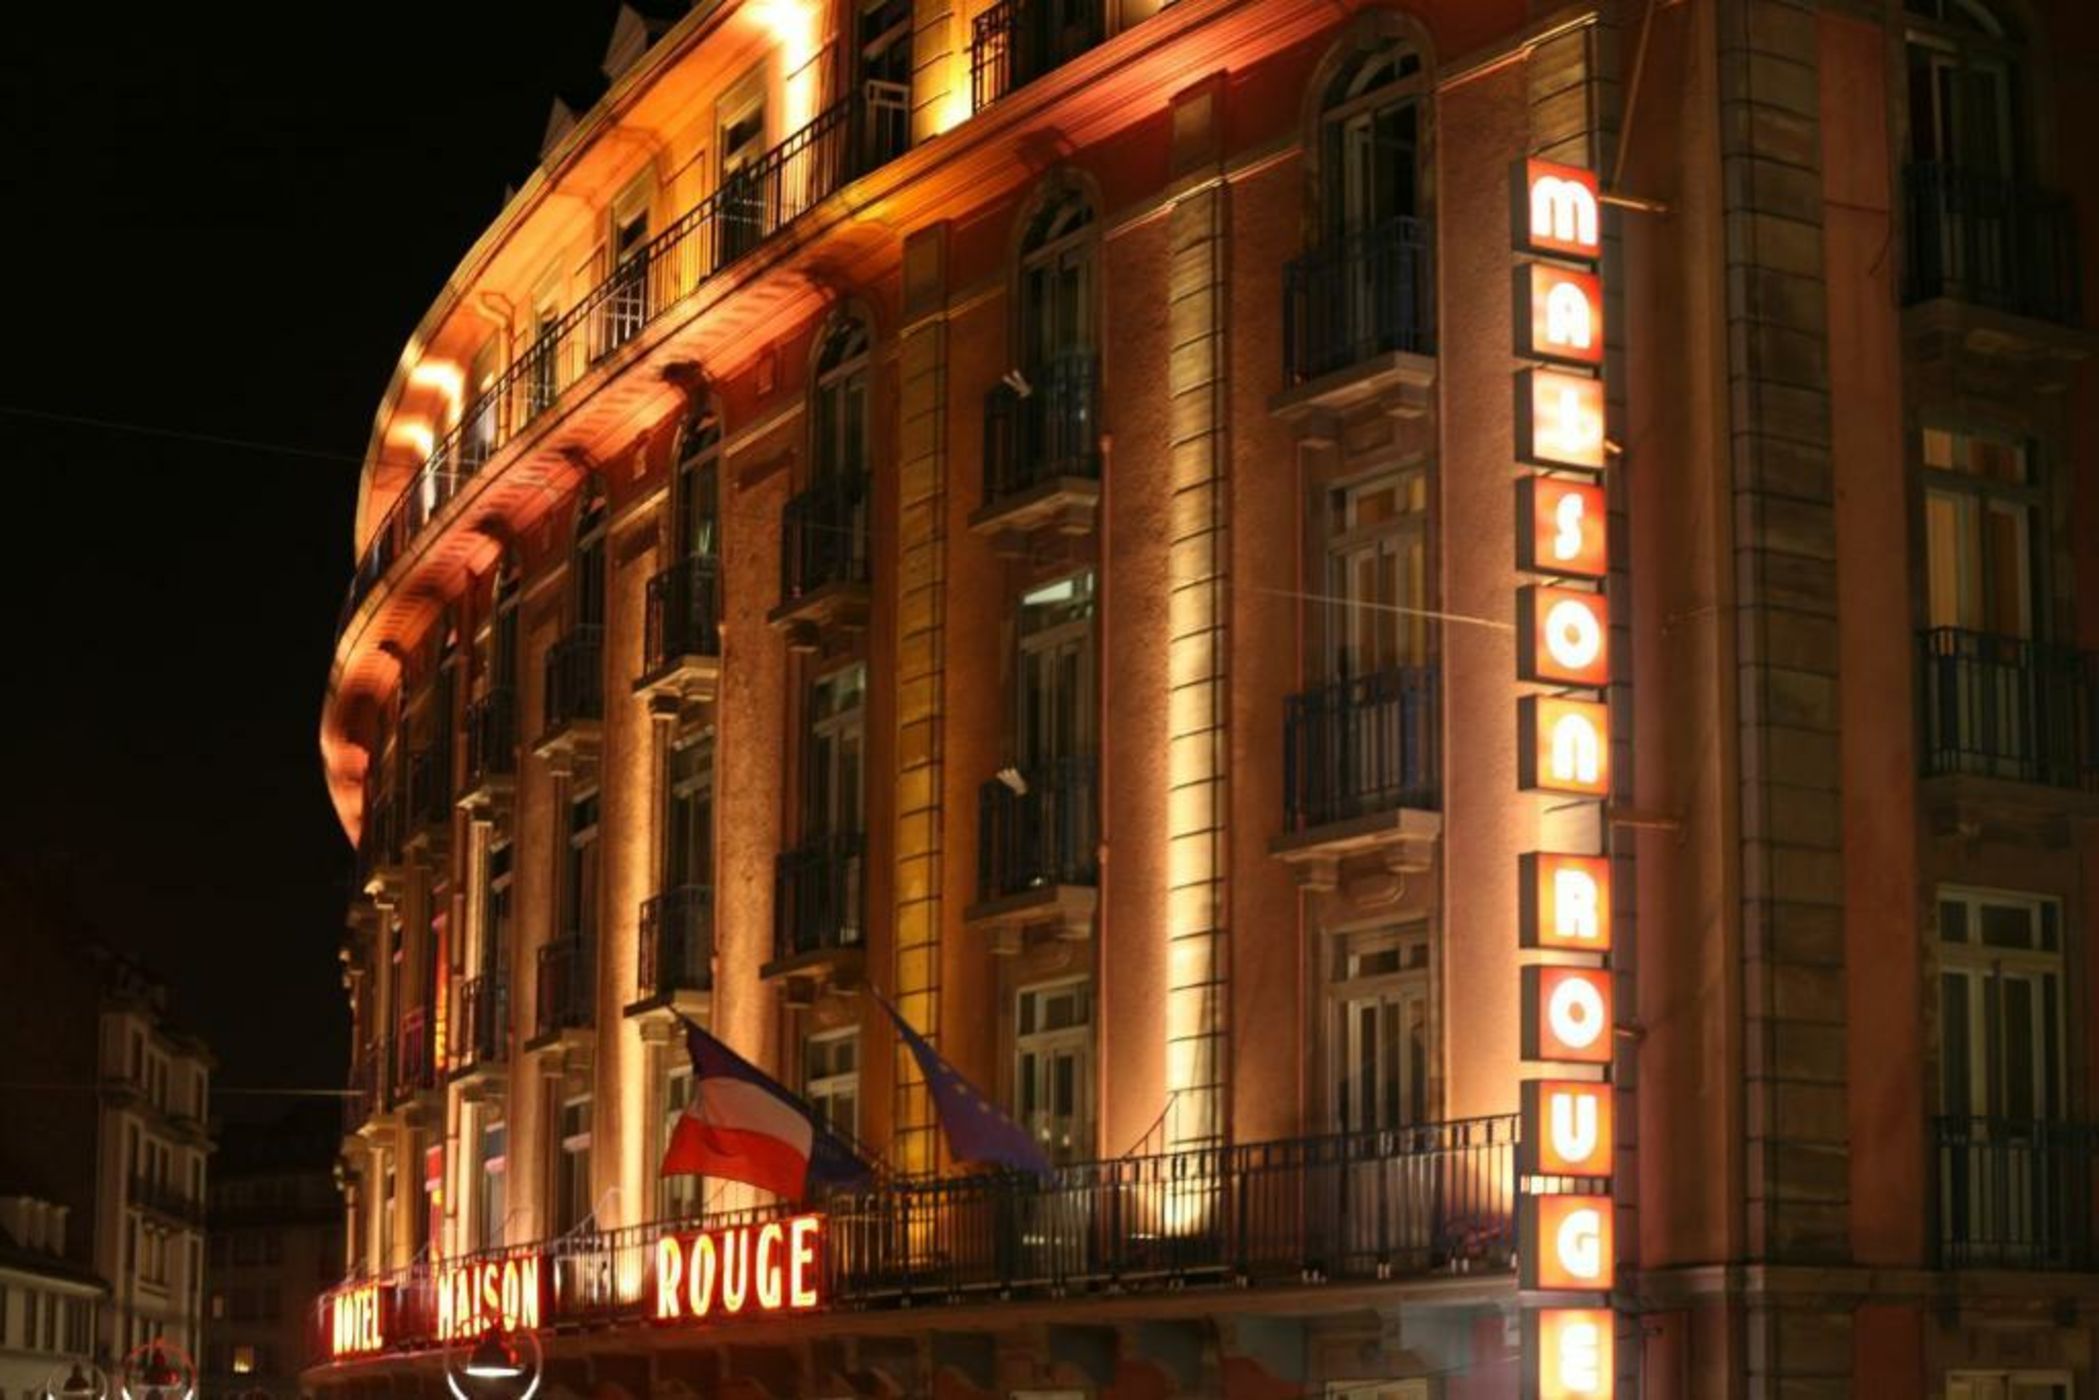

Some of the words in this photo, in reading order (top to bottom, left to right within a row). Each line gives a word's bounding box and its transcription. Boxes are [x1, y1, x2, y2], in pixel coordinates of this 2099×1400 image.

[1529, 175, 1600, 785] MAISON
[333, 1285, 383, 1354] HOTEL
[438, 1255, 539, 1341] MAISON
[656, 1216, 819, 1319] ROUGE
[1548, 868, 1604, 1392] ROUGE
